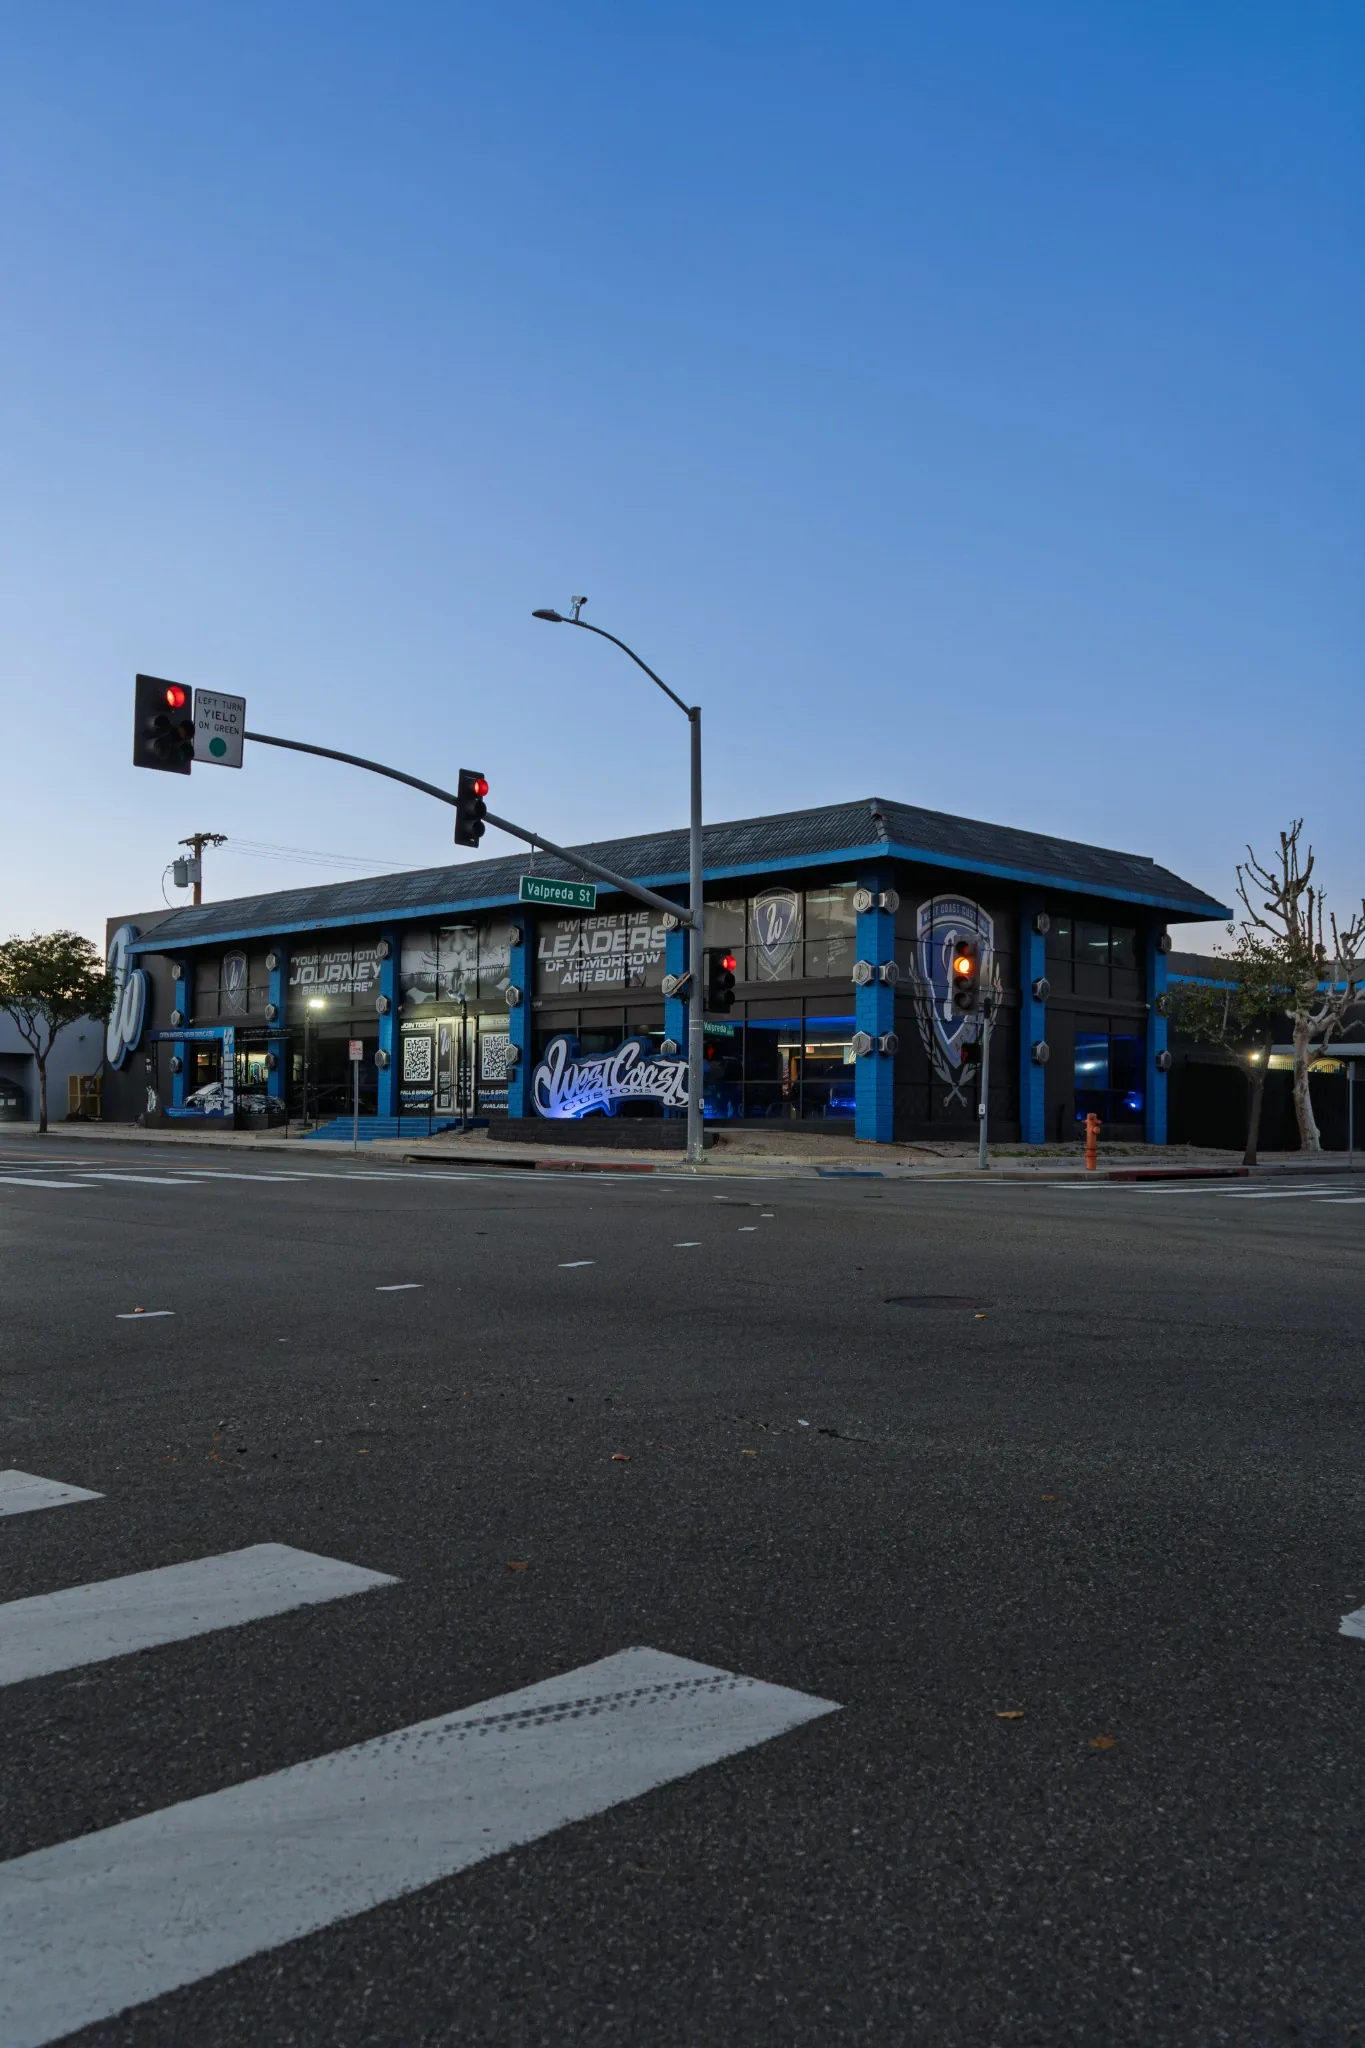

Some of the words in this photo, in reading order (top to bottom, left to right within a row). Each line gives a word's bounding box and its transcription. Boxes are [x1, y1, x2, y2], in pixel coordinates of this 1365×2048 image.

[198, 696, 217, 706] LEFT
[222, 700, 242, 711] TURN
[203, 708, 236, 723] YIELD
[198, 720, 210, 730] ON
[214, 723, 240, 735] GREEN
[527, 881, 574, 900] Valpreda
[579, 888, 591, 902] St
[940, 903, 961, 914] COAST
[558, 916, 618, 932] "WHERE
[619, 911, 650, 926] THE
[537, 924, 667, 959] LEADERS
[322, 950, 380, 963] AUTOMOTIV
[545, 959, 565, 973] OF
[568, 951, 661, 971] TOMORROW
[289, 961, 382, 985] JOURNEY
[561, 969, 593, 985] ARE
[594, 966, 645, 982] BUILT"
[301, 984, 339, 996] BEGINS
[340, 982, 373, 992] HERE"
[704, 1021, 727, 1034] Valpreda
[224, 1028, 234, 1116] WHIPS
[563, 1088, 652, 1111] CUSTOMS
